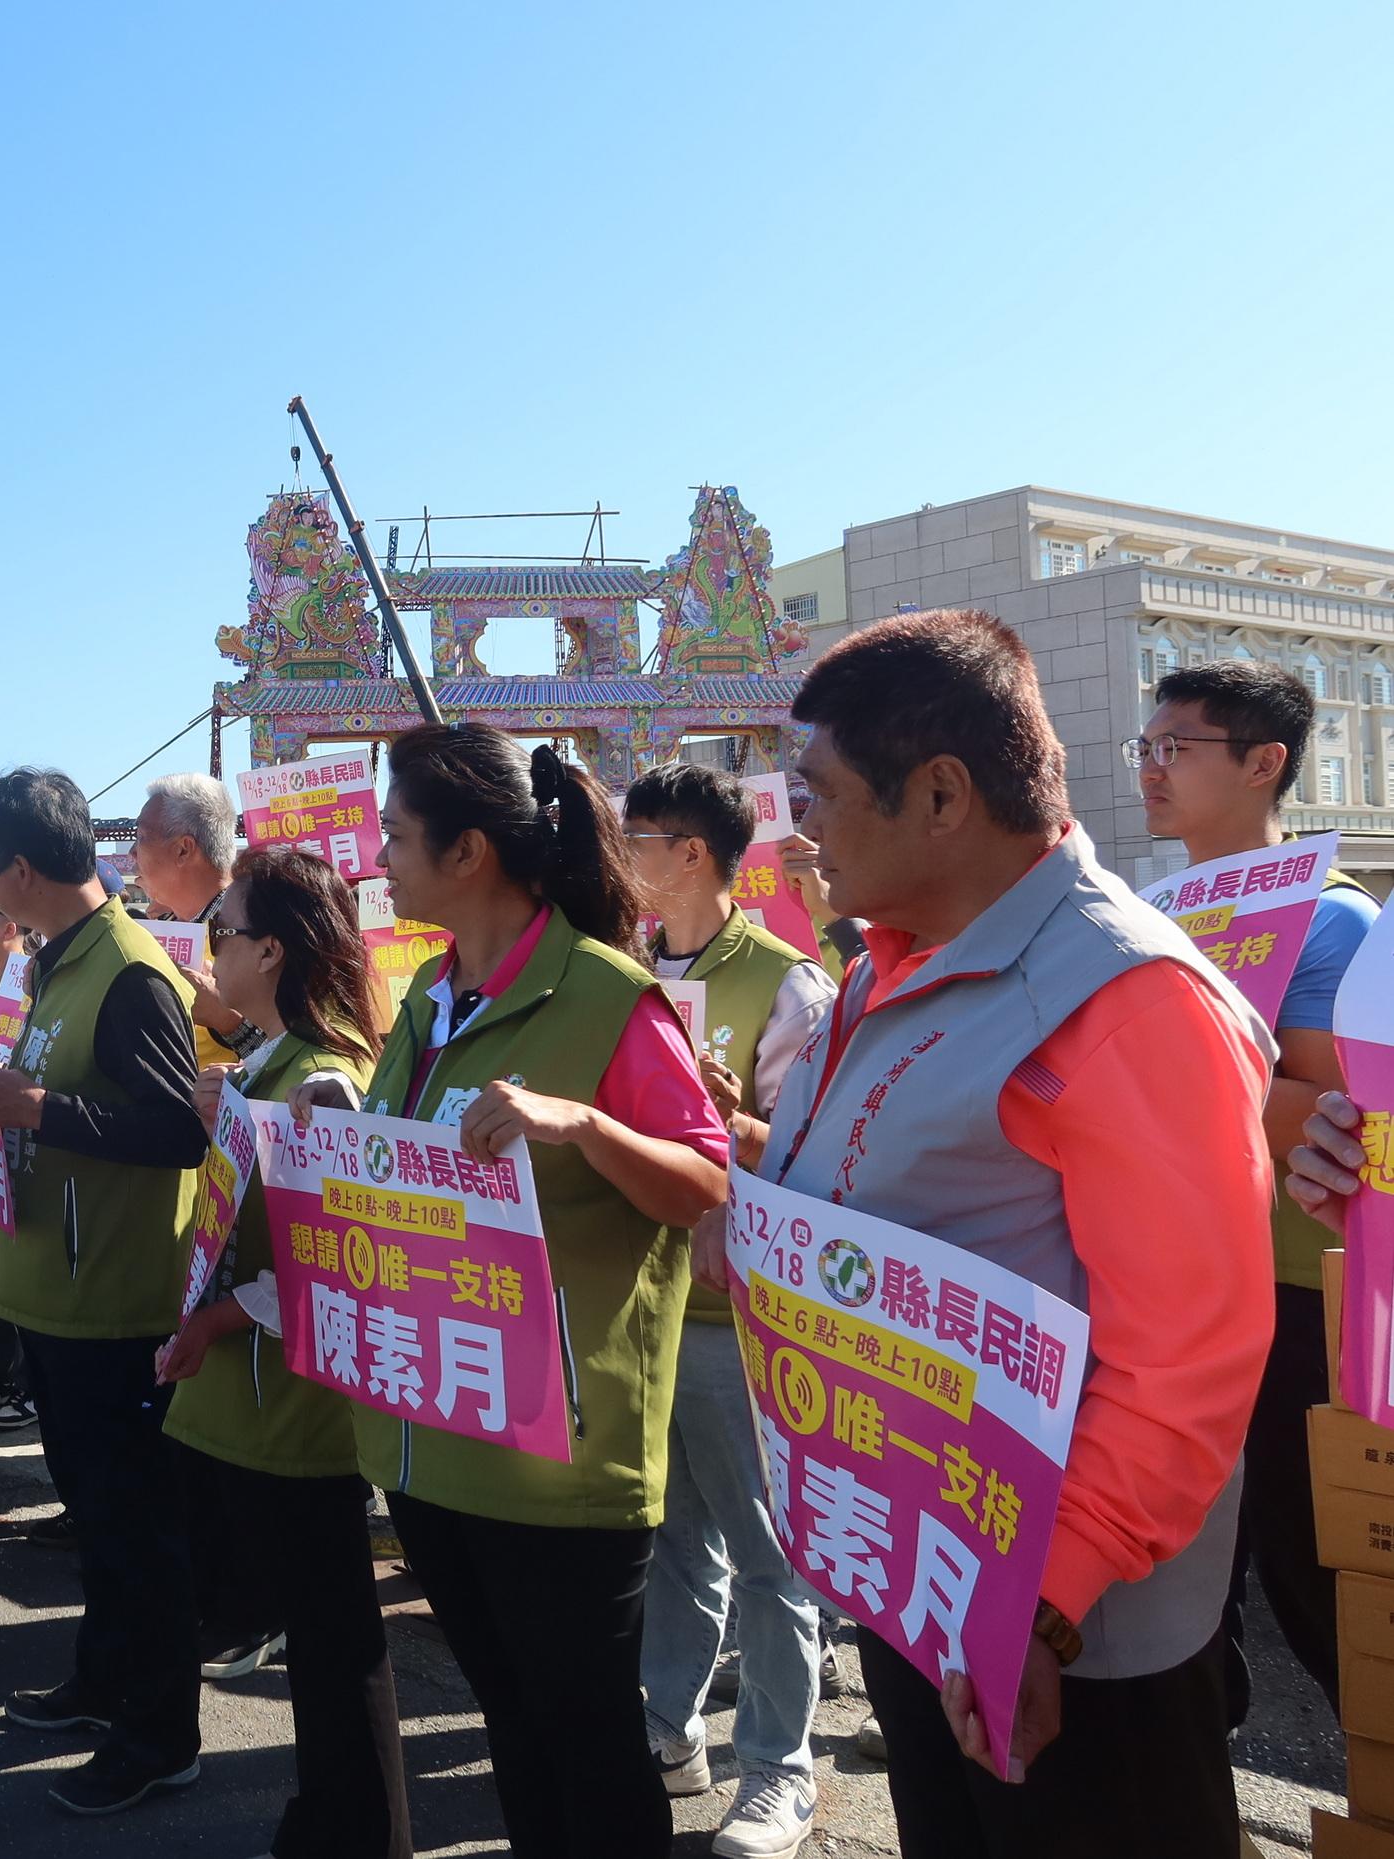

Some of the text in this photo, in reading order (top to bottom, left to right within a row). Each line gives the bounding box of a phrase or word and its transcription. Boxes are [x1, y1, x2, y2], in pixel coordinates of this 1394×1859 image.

[304, 760, 365, 788] 縣長民調
[300, 806, 364, 833] 唯一支持
[1174, 852, 1319, 912] 縣長民調
[1201, 932, 1278, 972] 支持
[396, 1138, 521, 1204] 縣長民調
[289, 1222, 525, 1316] 懇請 唯一支持
[310, 1281, 508, 1433] 陳素月
[879, 1255, 1067, 1411] 縣長民調
[833, 1384, 1025, 1557] 唯一支持
[757, 1410, 982, 1679] 陳素月
